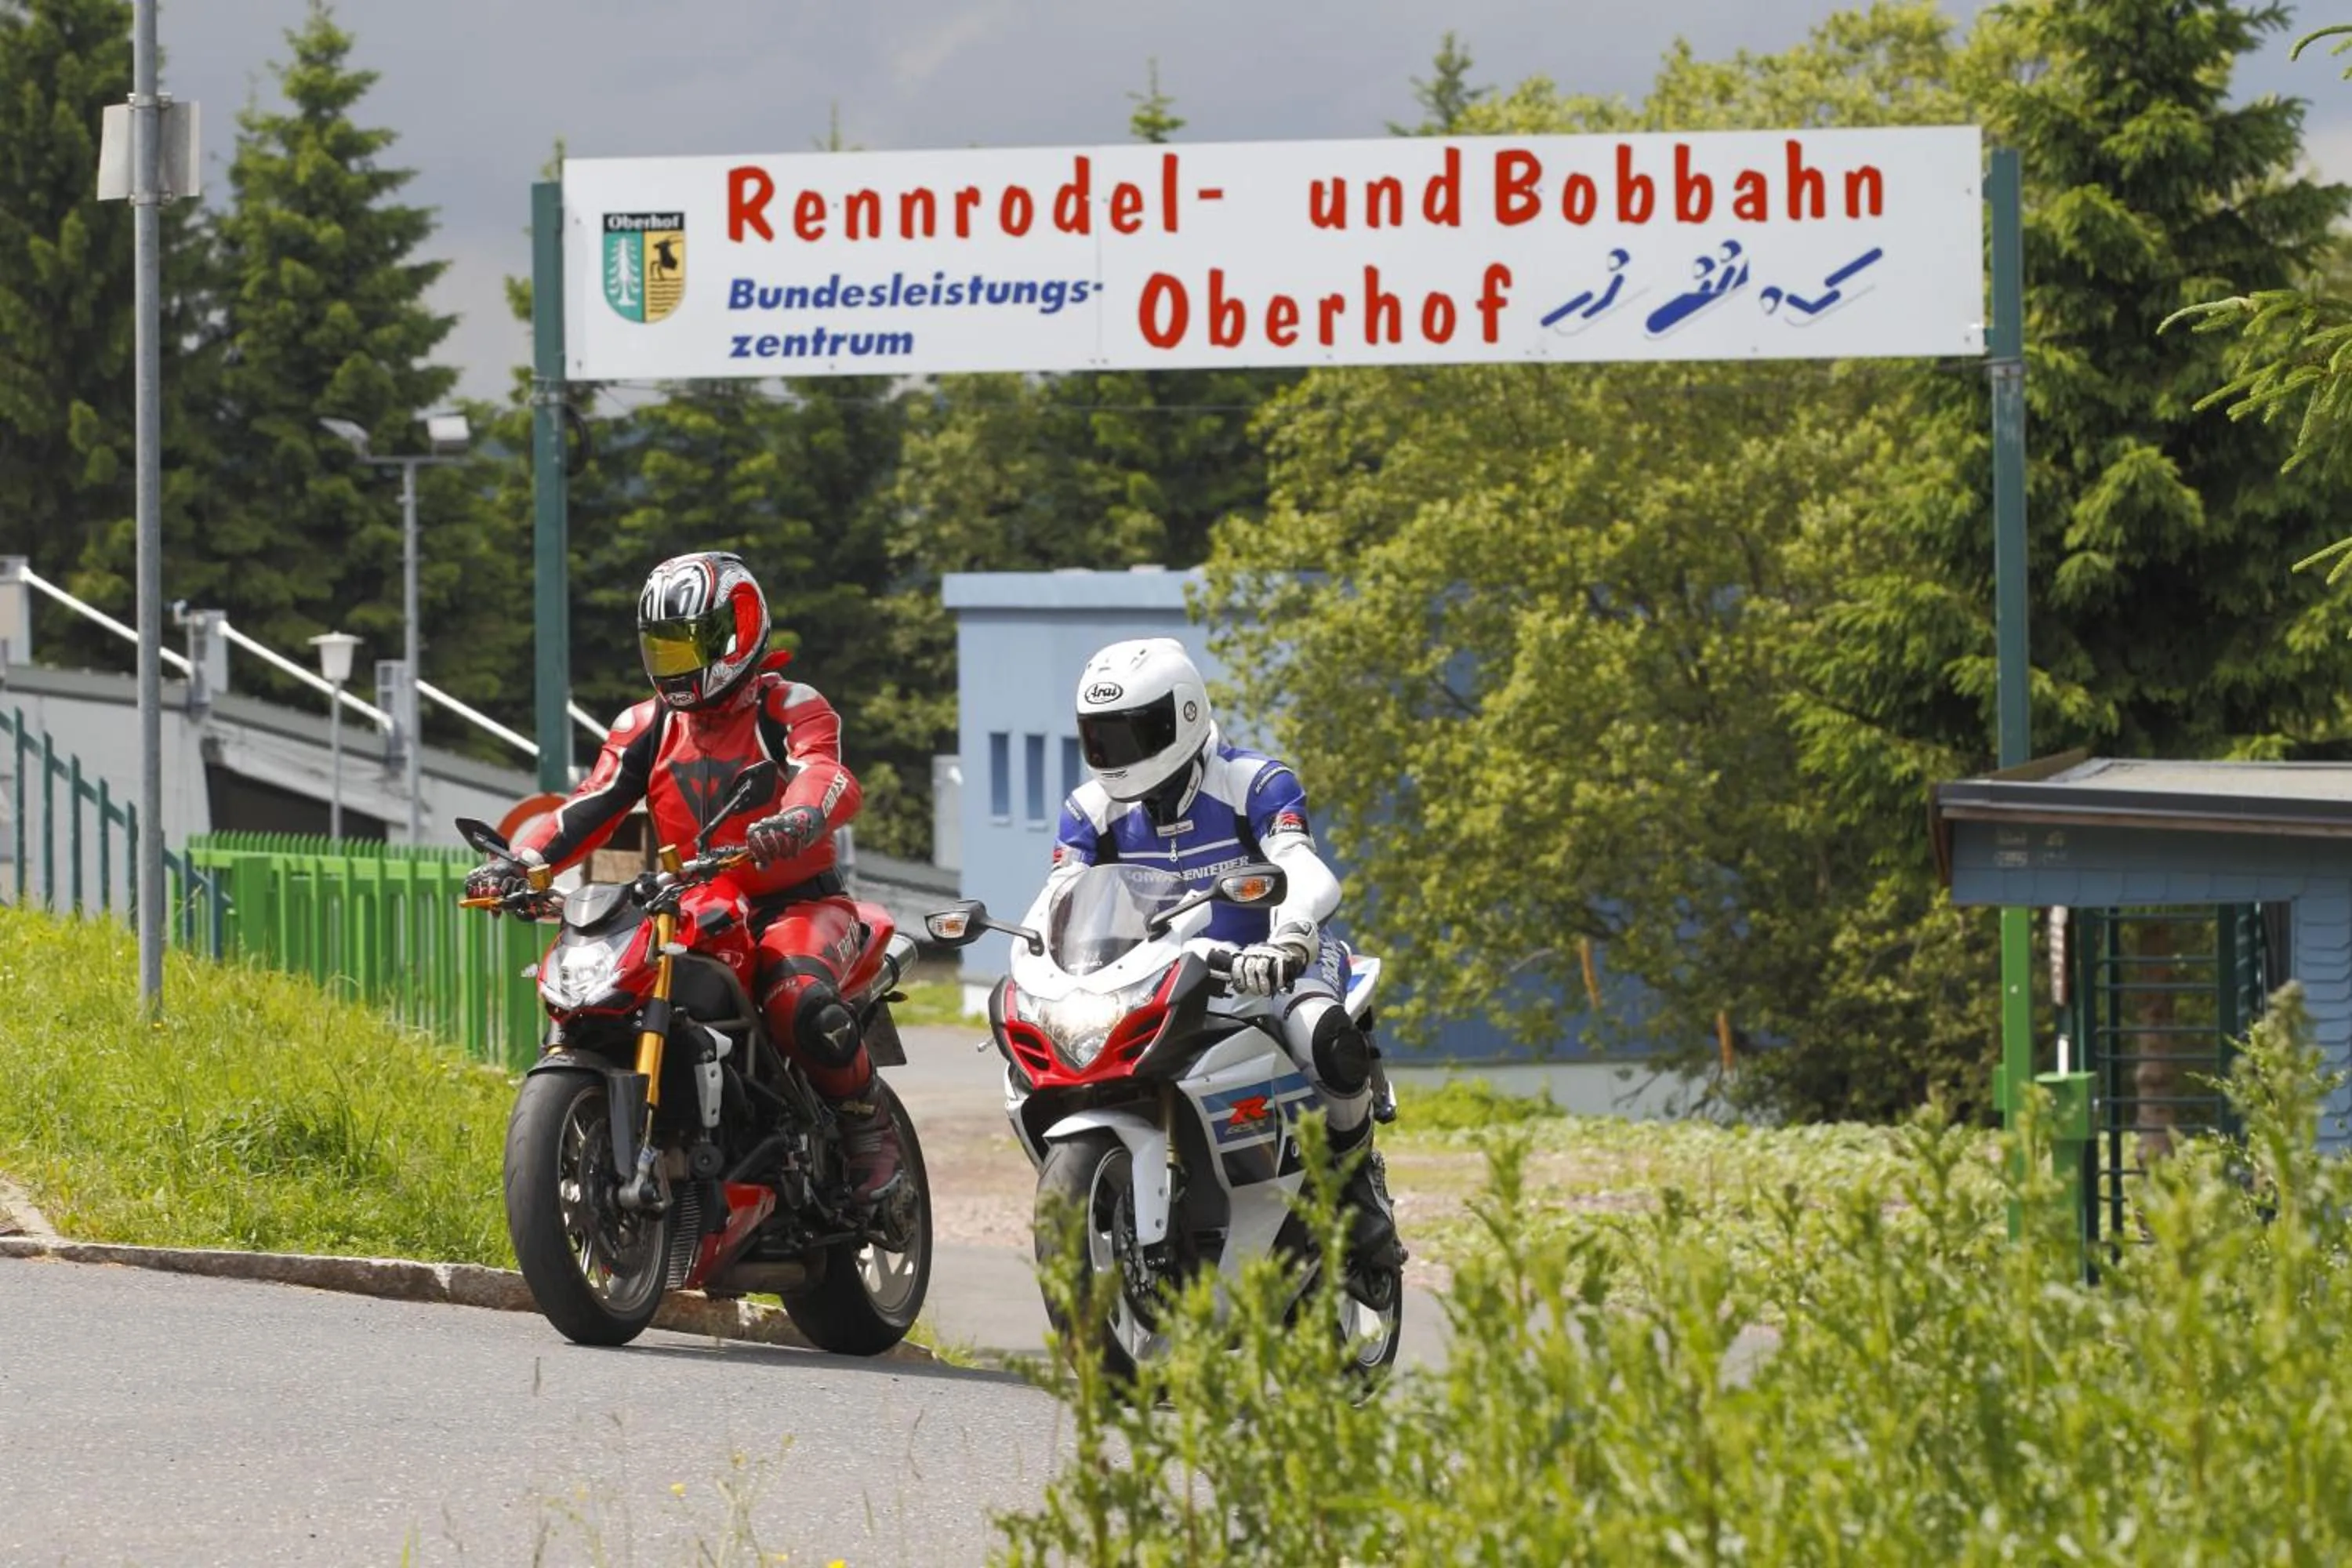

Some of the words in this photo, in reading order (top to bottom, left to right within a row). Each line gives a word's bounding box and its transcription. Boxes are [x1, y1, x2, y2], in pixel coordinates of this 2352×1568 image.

[728, 154, 1223, 242] Rennrodel-
[1310, 147, 1461, 230] und
[1494, 140, 1882, 227] Bobbahn
[607, 214, 681, 230] Oberhof
[728, 273, 1104, 314] Bundesleistungs-
[1138, 263, 1512, 349] Oberhof
[730, 327, 913, 358] zentrum
[1091, 684, 1118, 699] Arai
